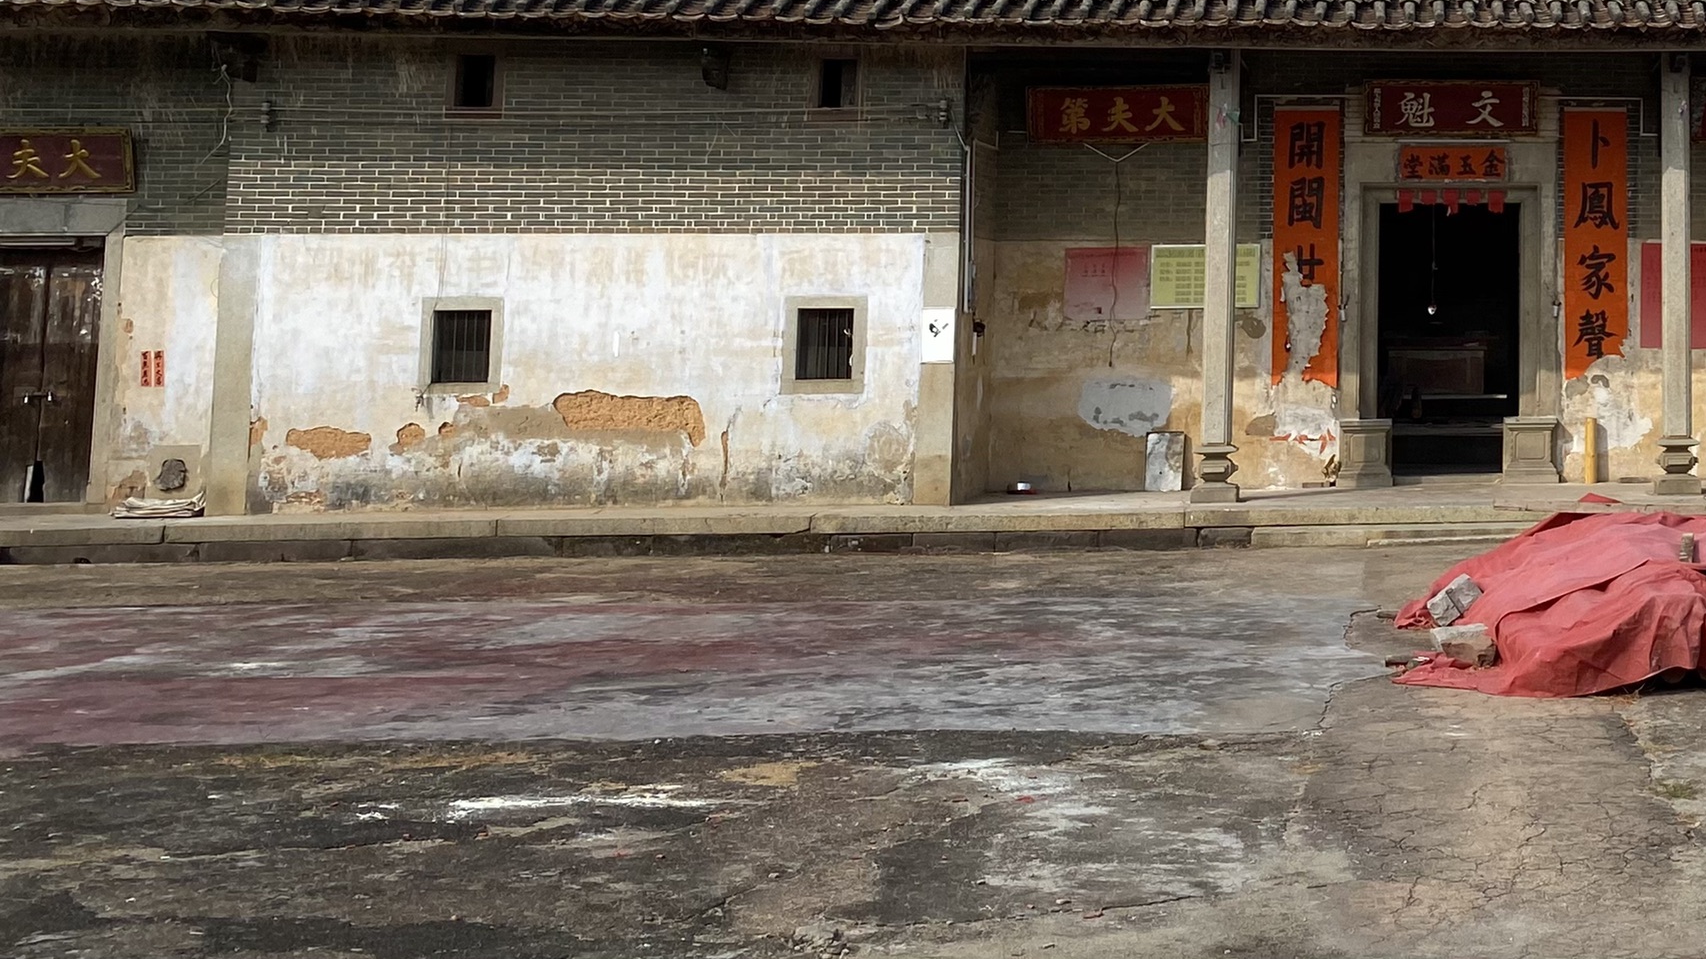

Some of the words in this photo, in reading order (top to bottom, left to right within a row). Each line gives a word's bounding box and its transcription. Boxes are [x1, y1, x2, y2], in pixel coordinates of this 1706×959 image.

[1058, 96, 1186, 135] 大夫第
[1395, 90, 1504, 128] 文魁
[6, 139, 102, 179] 大夫
[1403, 149, 1505, 179] 金玉滿堂
[1573, 118, 1621, 360] 卜鳳家聲
